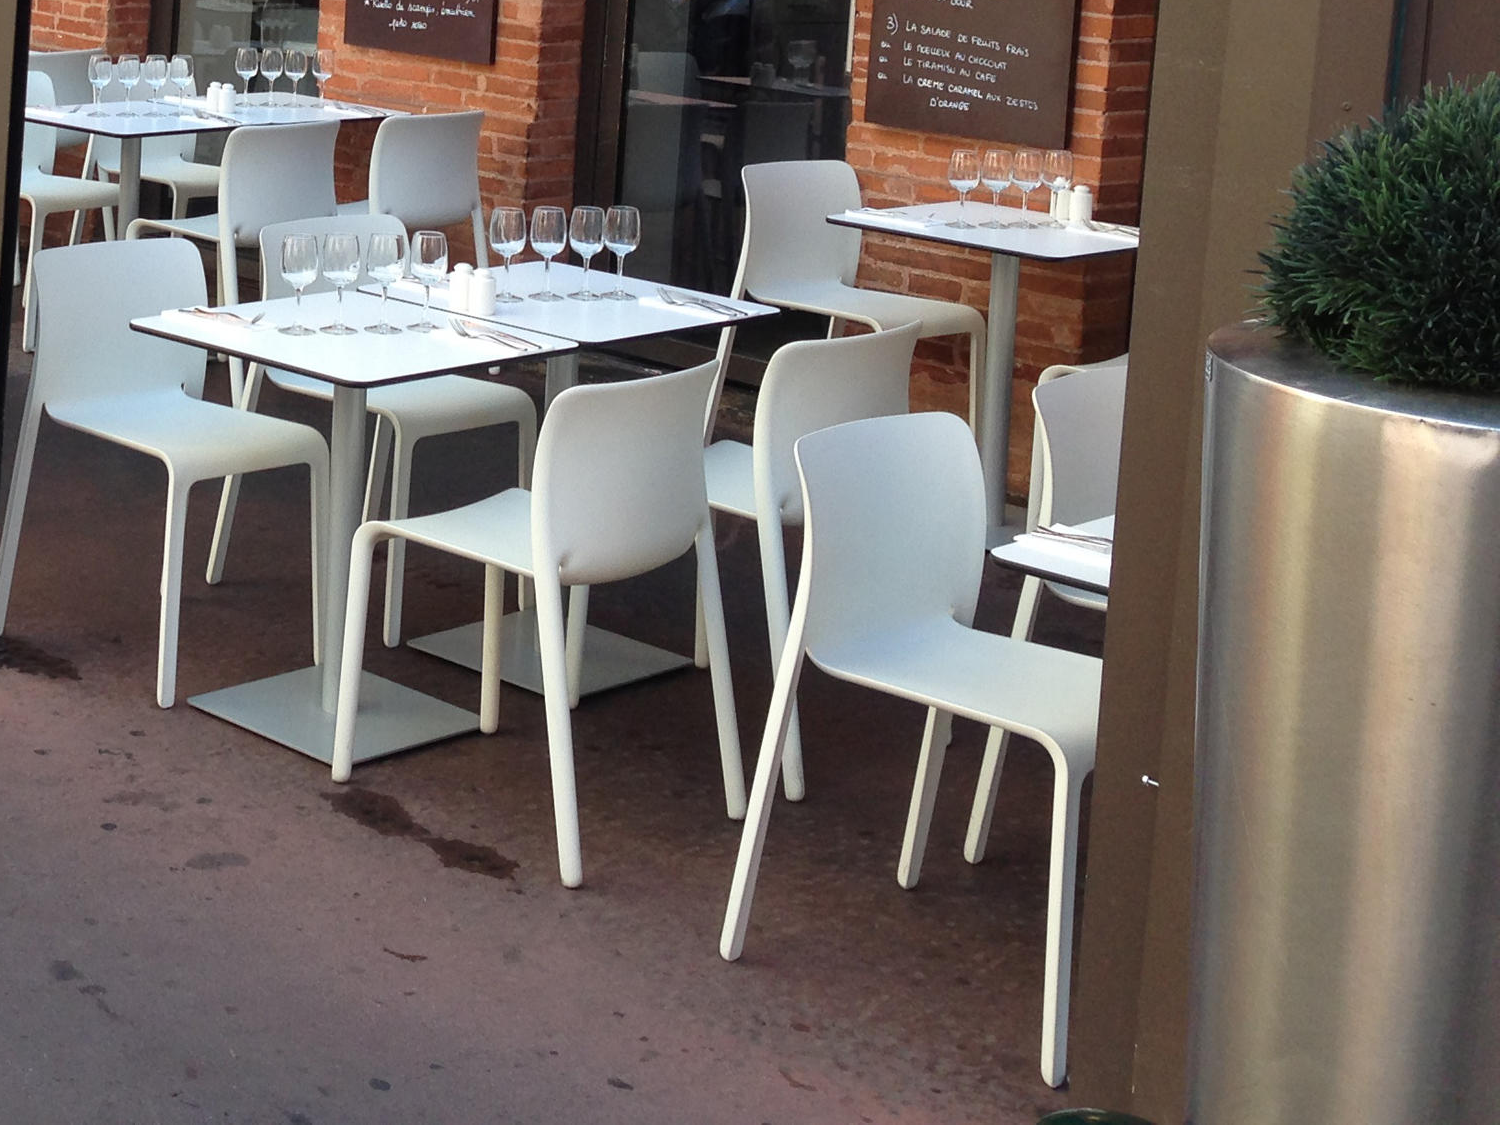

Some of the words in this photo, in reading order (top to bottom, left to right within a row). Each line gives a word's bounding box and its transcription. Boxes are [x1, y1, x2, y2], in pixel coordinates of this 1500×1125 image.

[886, 13, 899, 36] 3)
[905, 19, 917, 33] LA
[920, 24, 951, 39] SALADE
[957, 34, 969, 44] DE
[971, 35, 1000, 51] FRUITS
[903, 56, 912, 67] LE
[916, 59, 956, 75] TIRAMISU
[959, 67, 971, 77] AU
[955, 52, 966, 62] AU
[968, 55, 1008, 71] CHOCOLAT
[902, 73, 913, 84] LA
[917, 77, 945, 91] CREME
[948, 84, 983, 99] CARAMEL
[985, 92, 1001, 103] AUX
[1005, 96, 1039, 111] ZESTES
[929, 97, 970, 111] D'ORANGE
